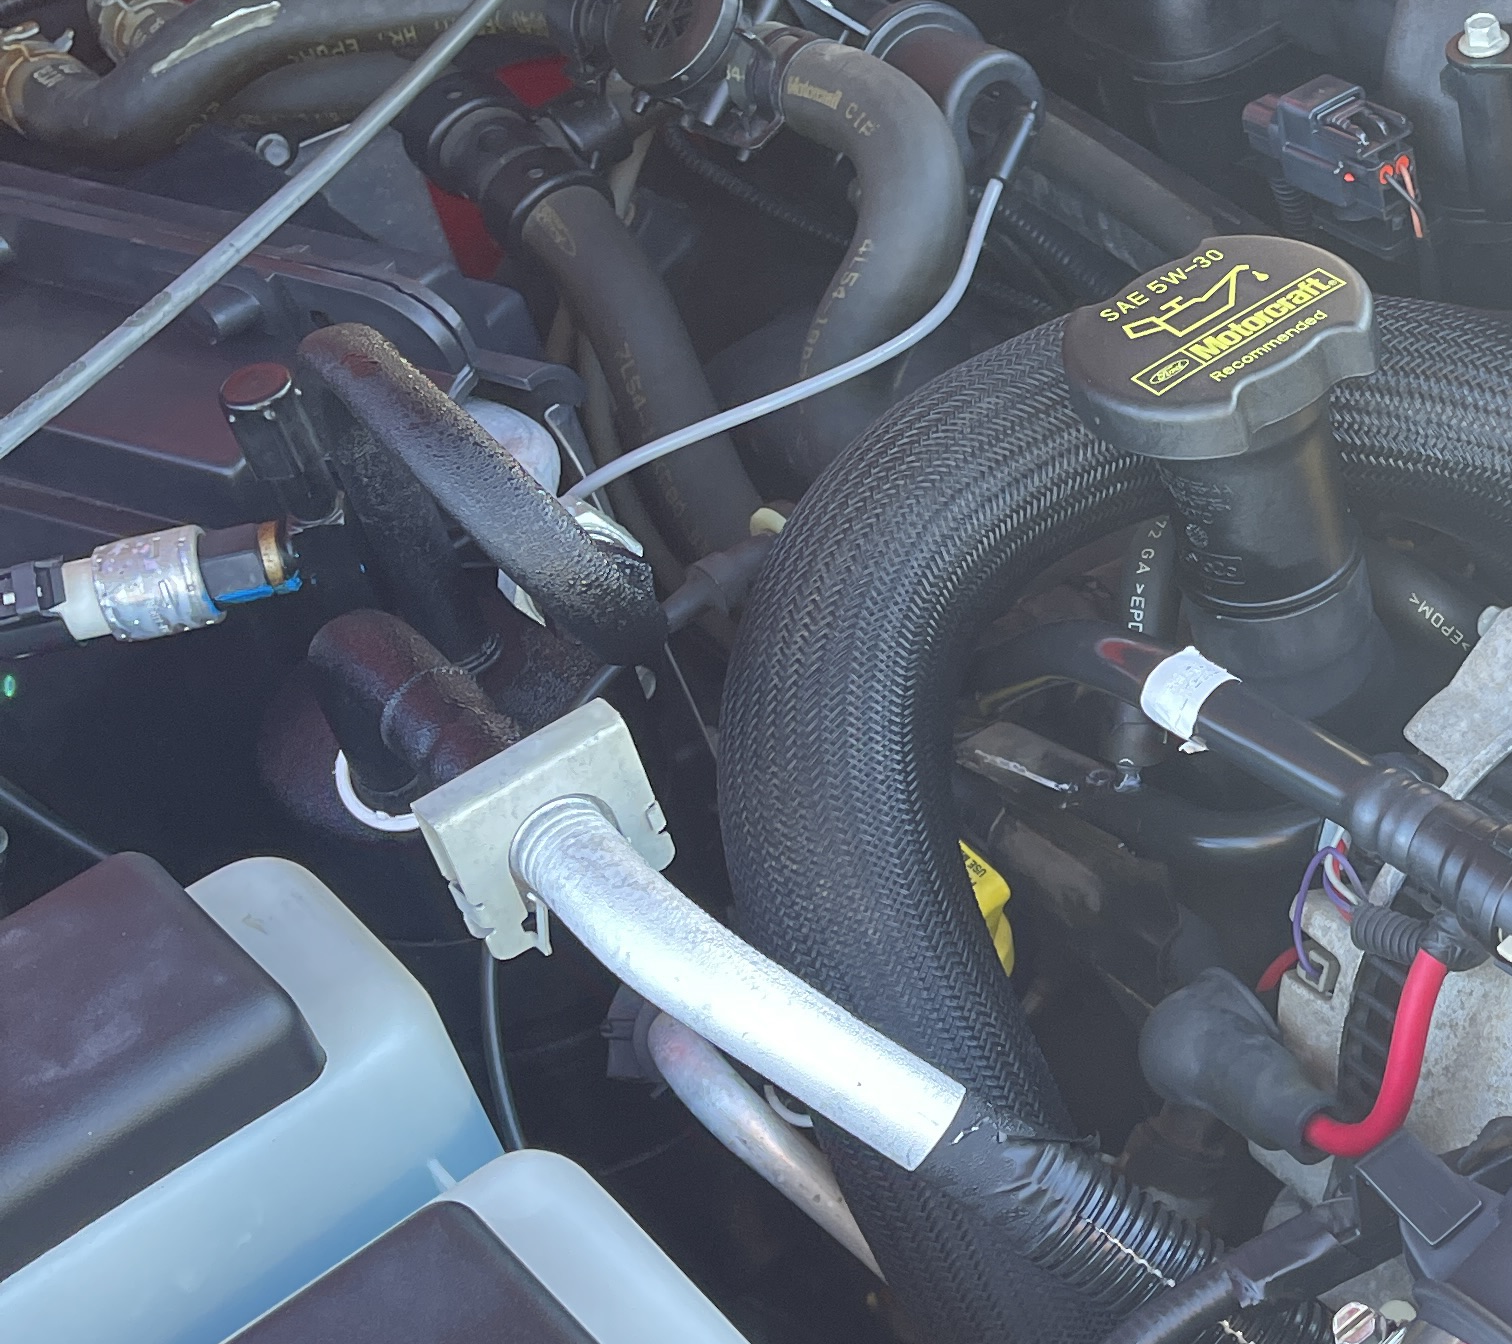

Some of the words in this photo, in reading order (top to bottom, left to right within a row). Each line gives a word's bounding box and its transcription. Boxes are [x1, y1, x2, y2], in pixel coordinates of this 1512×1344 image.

[1100, 291, 1150, 323] SAE
[1145, 249, 1224, 294] 5W-30
[1209, 309, 1328, 382] Recommended
[1136, 548, 1155, 574] GA
